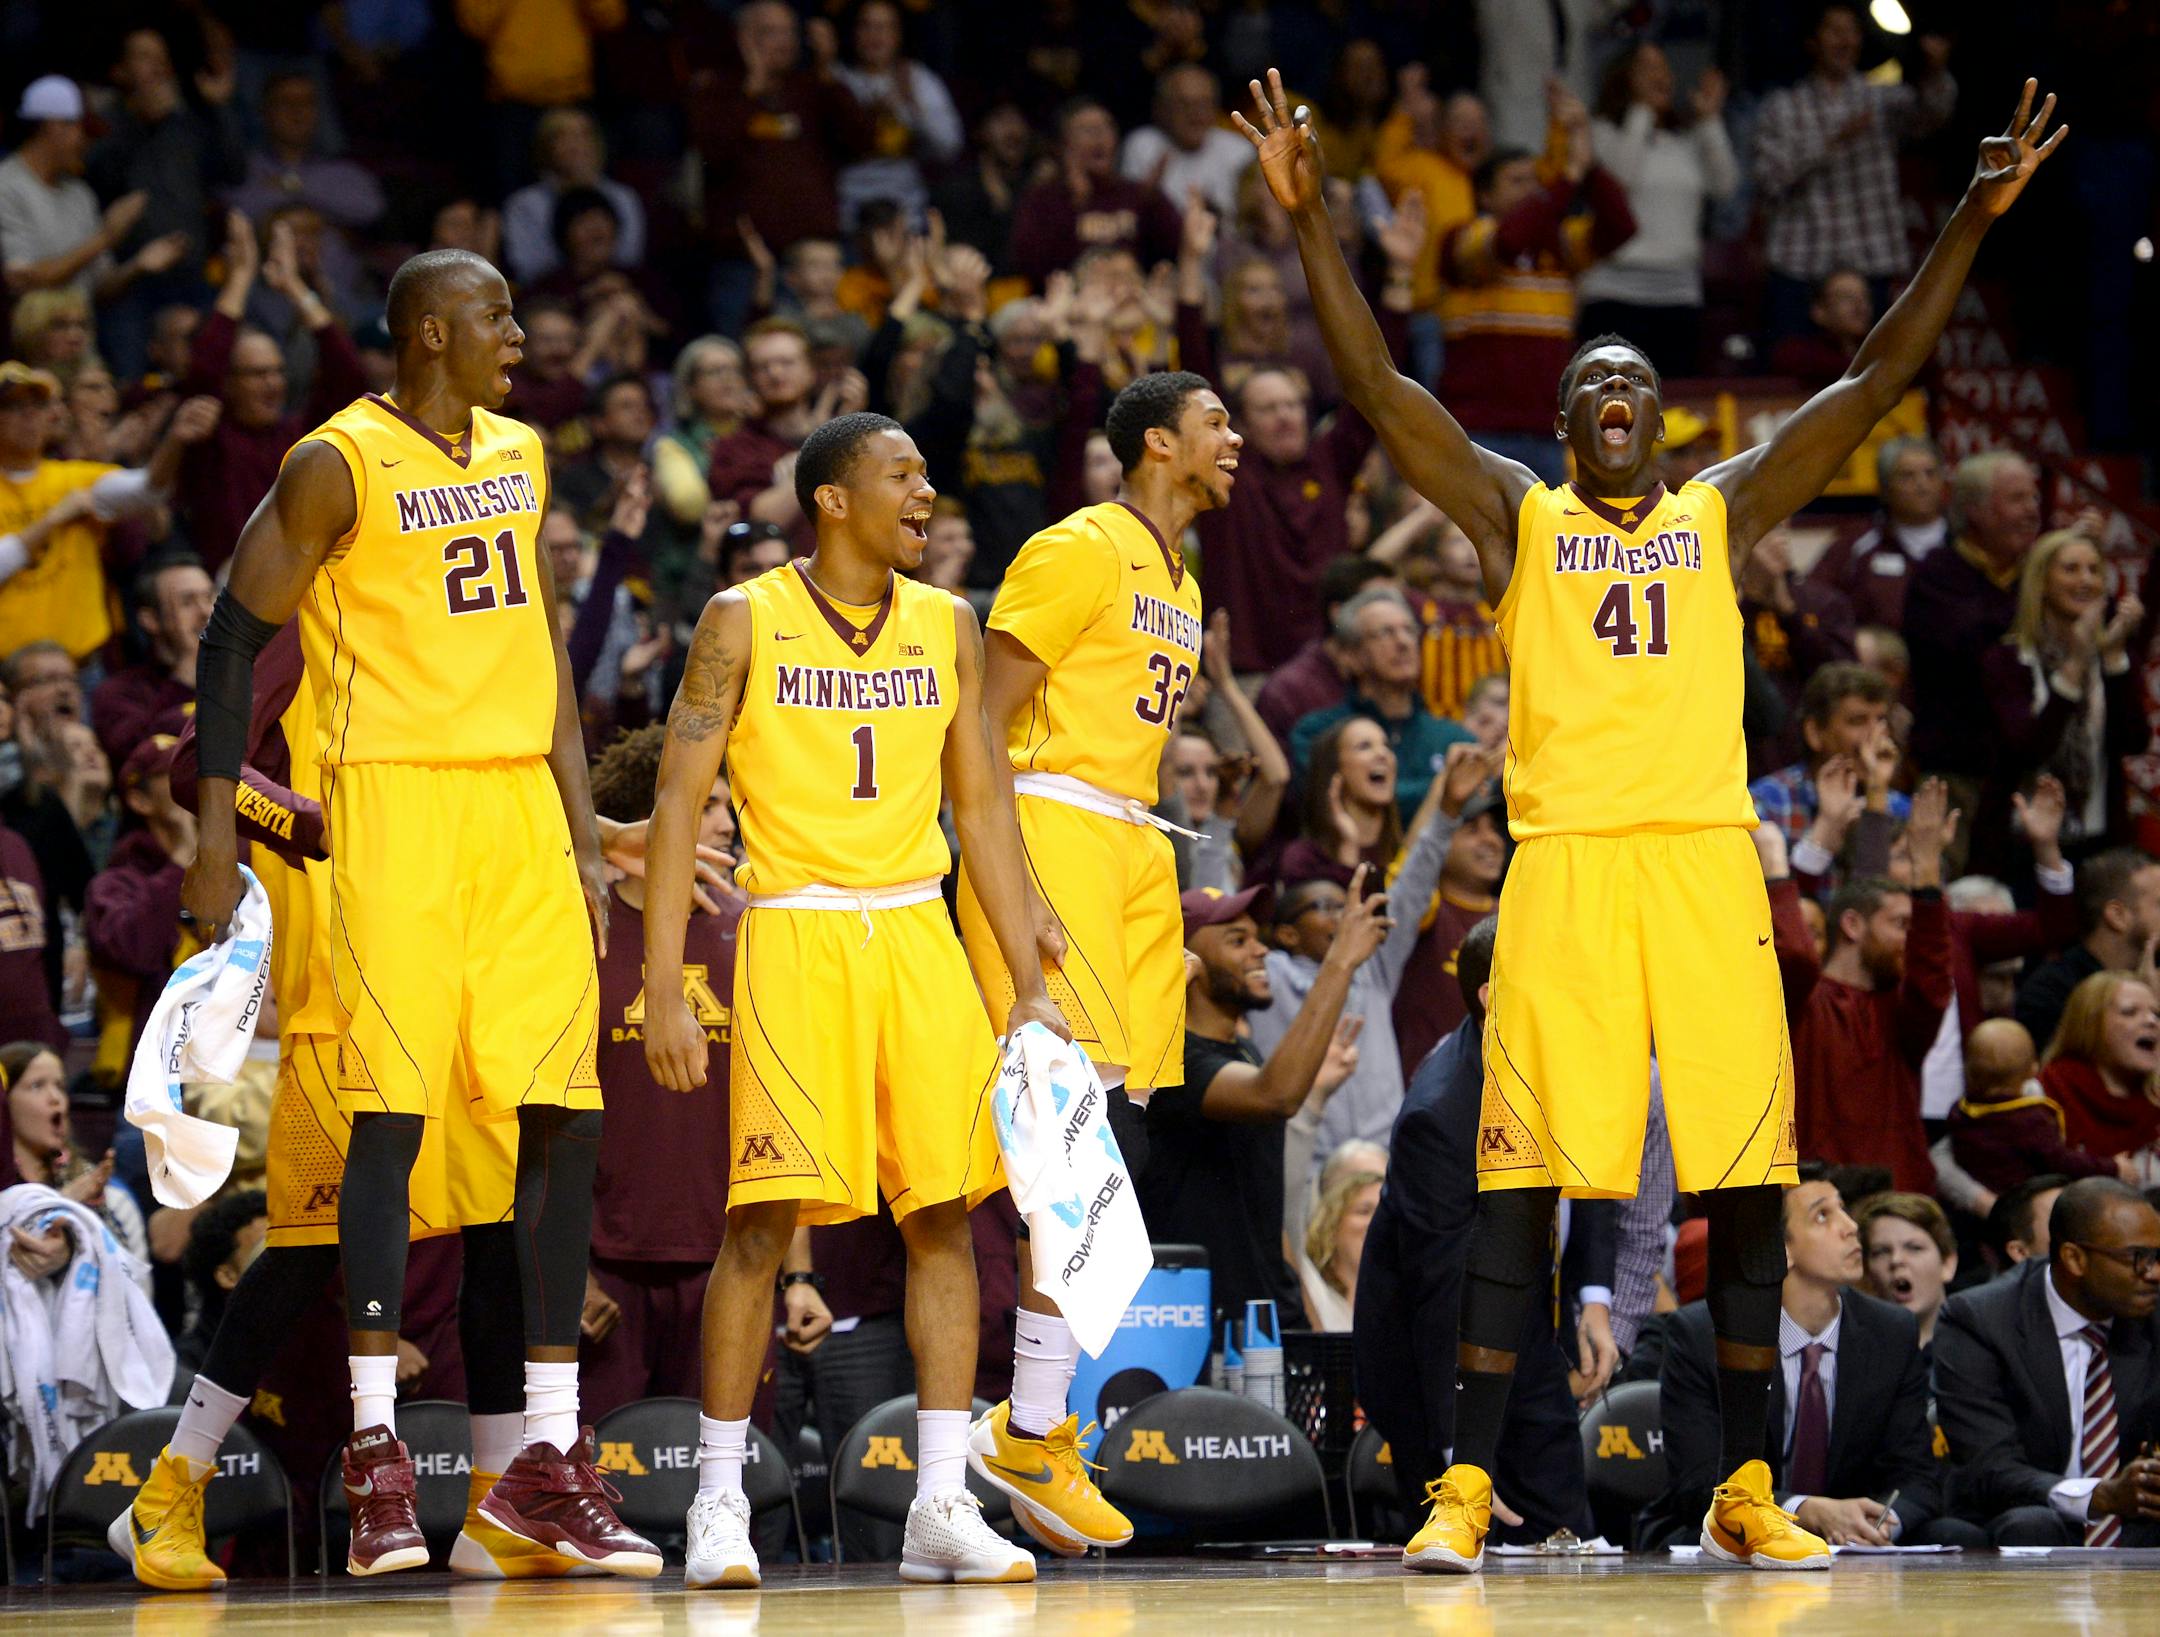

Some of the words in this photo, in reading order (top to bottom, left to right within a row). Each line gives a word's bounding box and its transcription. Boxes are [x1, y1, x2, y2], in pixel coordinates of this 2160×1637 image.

[396, 472, 538, 533] MINNESOTA
[443, 529, 530, 616] 21
[1555, 531, 1702, 575] MINNESOTA
[1131, 592, 1203, 661] MINNESO
[1592, 581, 1669, 658] 41
[775, 664, 942, 710] MINNESOTA
[1135, 652, 1192, 734] 32
[850, 723, 880, 801] 1
[235, 780, 296, 841] NESOTA
[236, 916, 274, 1034] POWER
[1061, 1171, 1125, 1288] POWERADE
[1118, 1304, 1206, 1329] ERADE
[414, 1453, 473, 1477] HEA
[653, 1441, 761, 1470] HEAH
[1184, 1434, 1291, 1460] HEALTH
